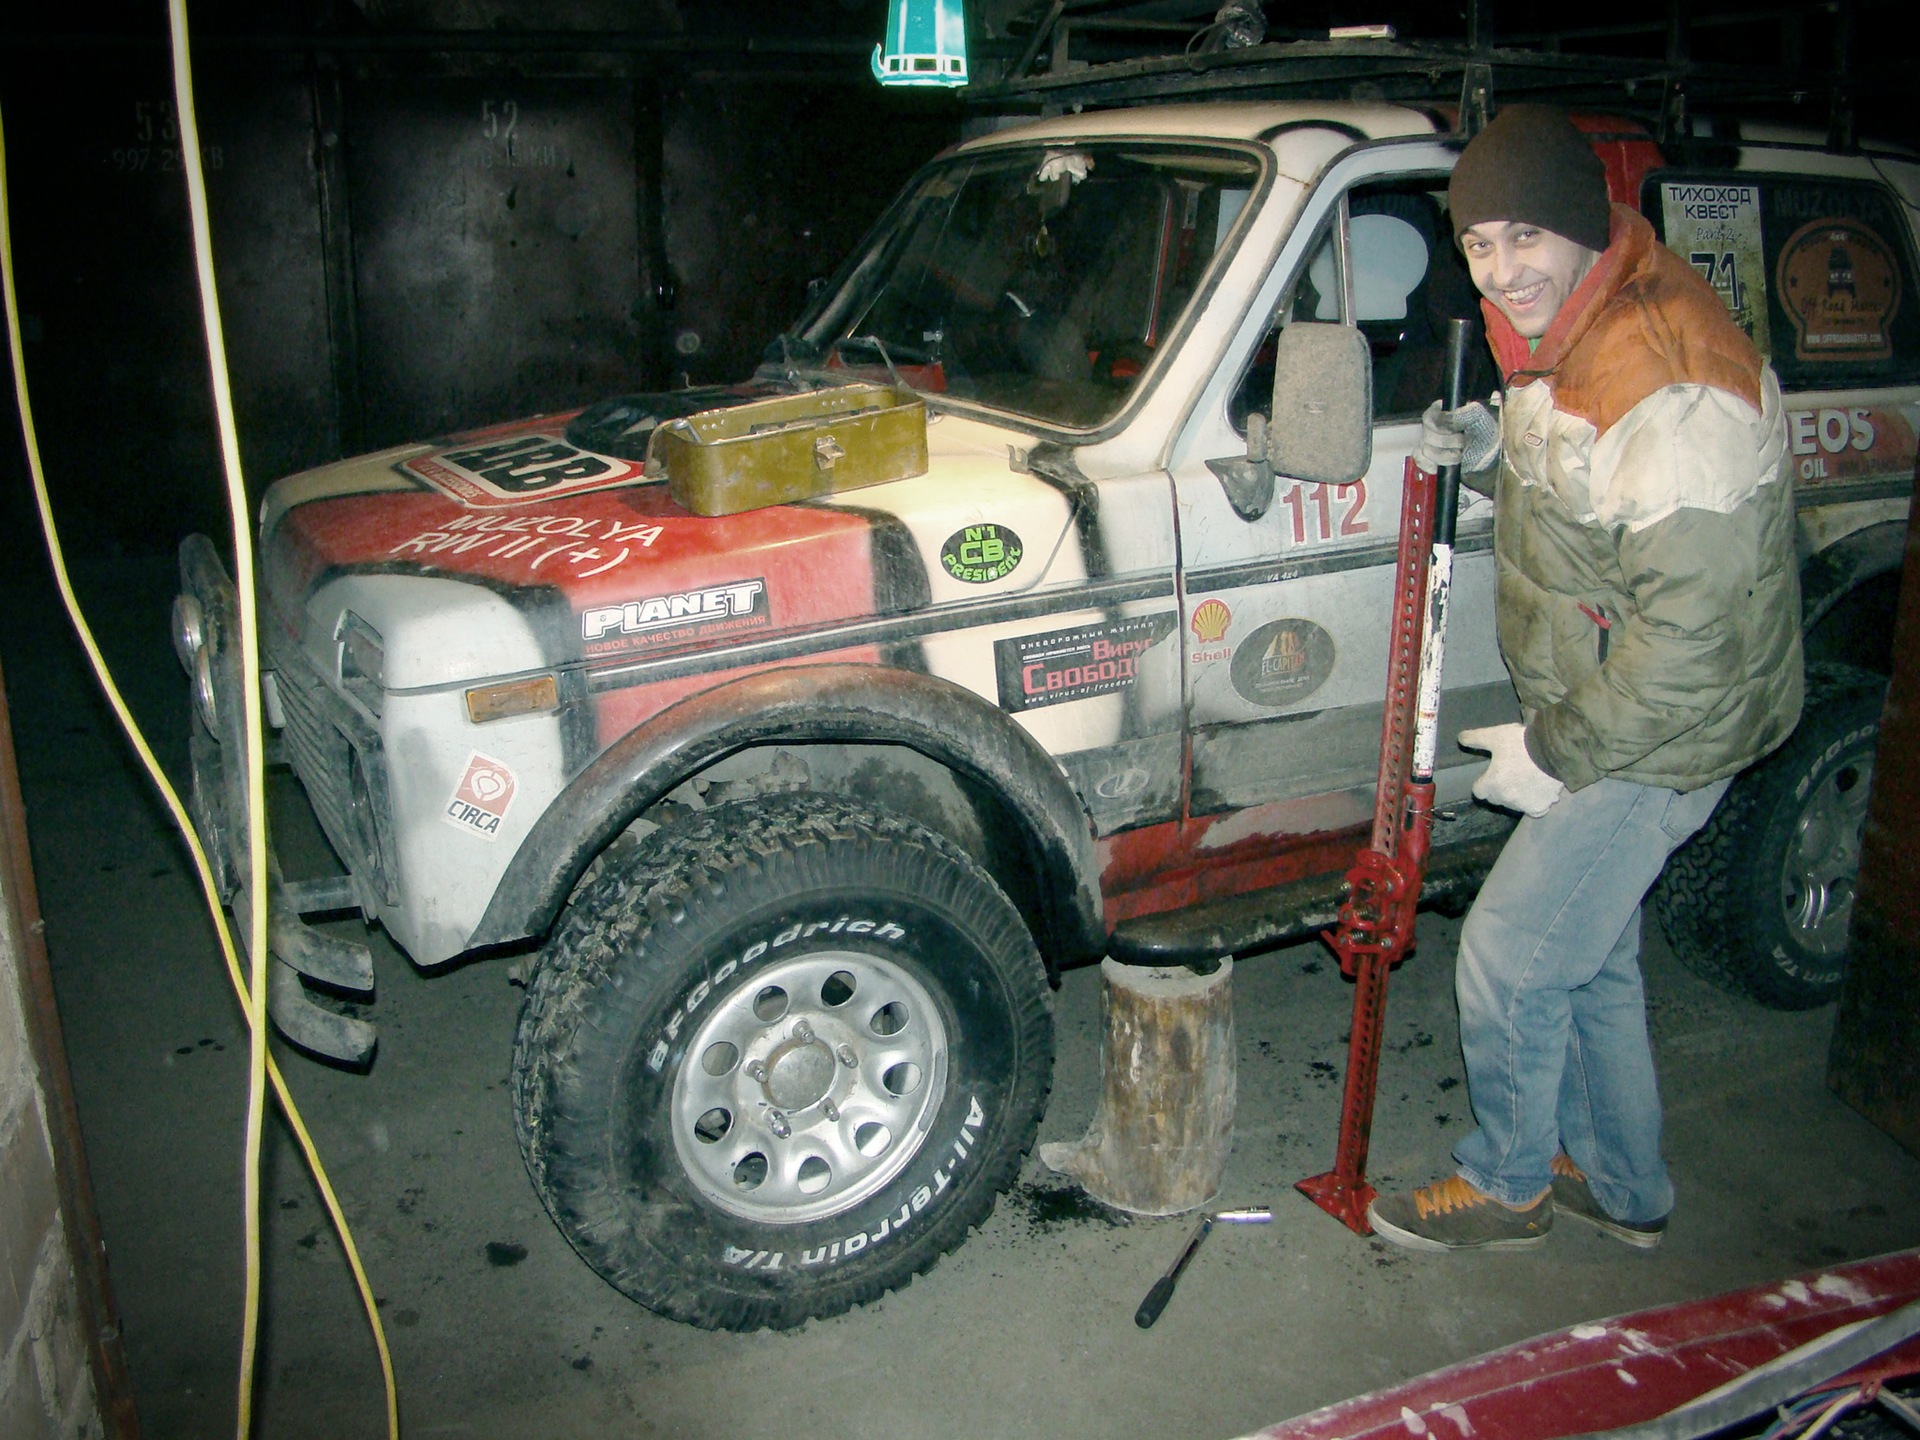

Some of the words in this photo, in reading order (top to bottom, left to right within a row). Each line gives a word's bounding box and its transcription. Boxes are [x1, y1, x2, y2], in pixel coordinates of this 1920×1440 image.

[482, 99, 518, 139] 52
[1668, 187, 1751, 205] ТИХОХОД
[1684, 205, 1738, 220] КВЕСТ
[1696, 228, 1722, 241] Part
[1725, 228, 1735, 241] 2
[1690, 252, 1740, 310] 71
[1788, 407, 1876, 456] EOS
[441, 437, 612, 492] ARB
[1800, 458, 1829, 480] OIL
[1280, 478, 1370, 545] 112
[389, 533, 505, 555] RW
[438, 514, 664, 548] MUZOLYA
[582, 581, 763, 641] PLANET
[584, 639, 629, 654] НОВОЕ
[632, 629, 695, 646] КАЧЕСТВО
[699, 616, 766, 636] ДВИЖЕНИЯ
[1191, 648, 1232, 663] Shell
[801, 1095, 985, 1266] All-Terrain
[723, 1245, 784, 1270] T/A
